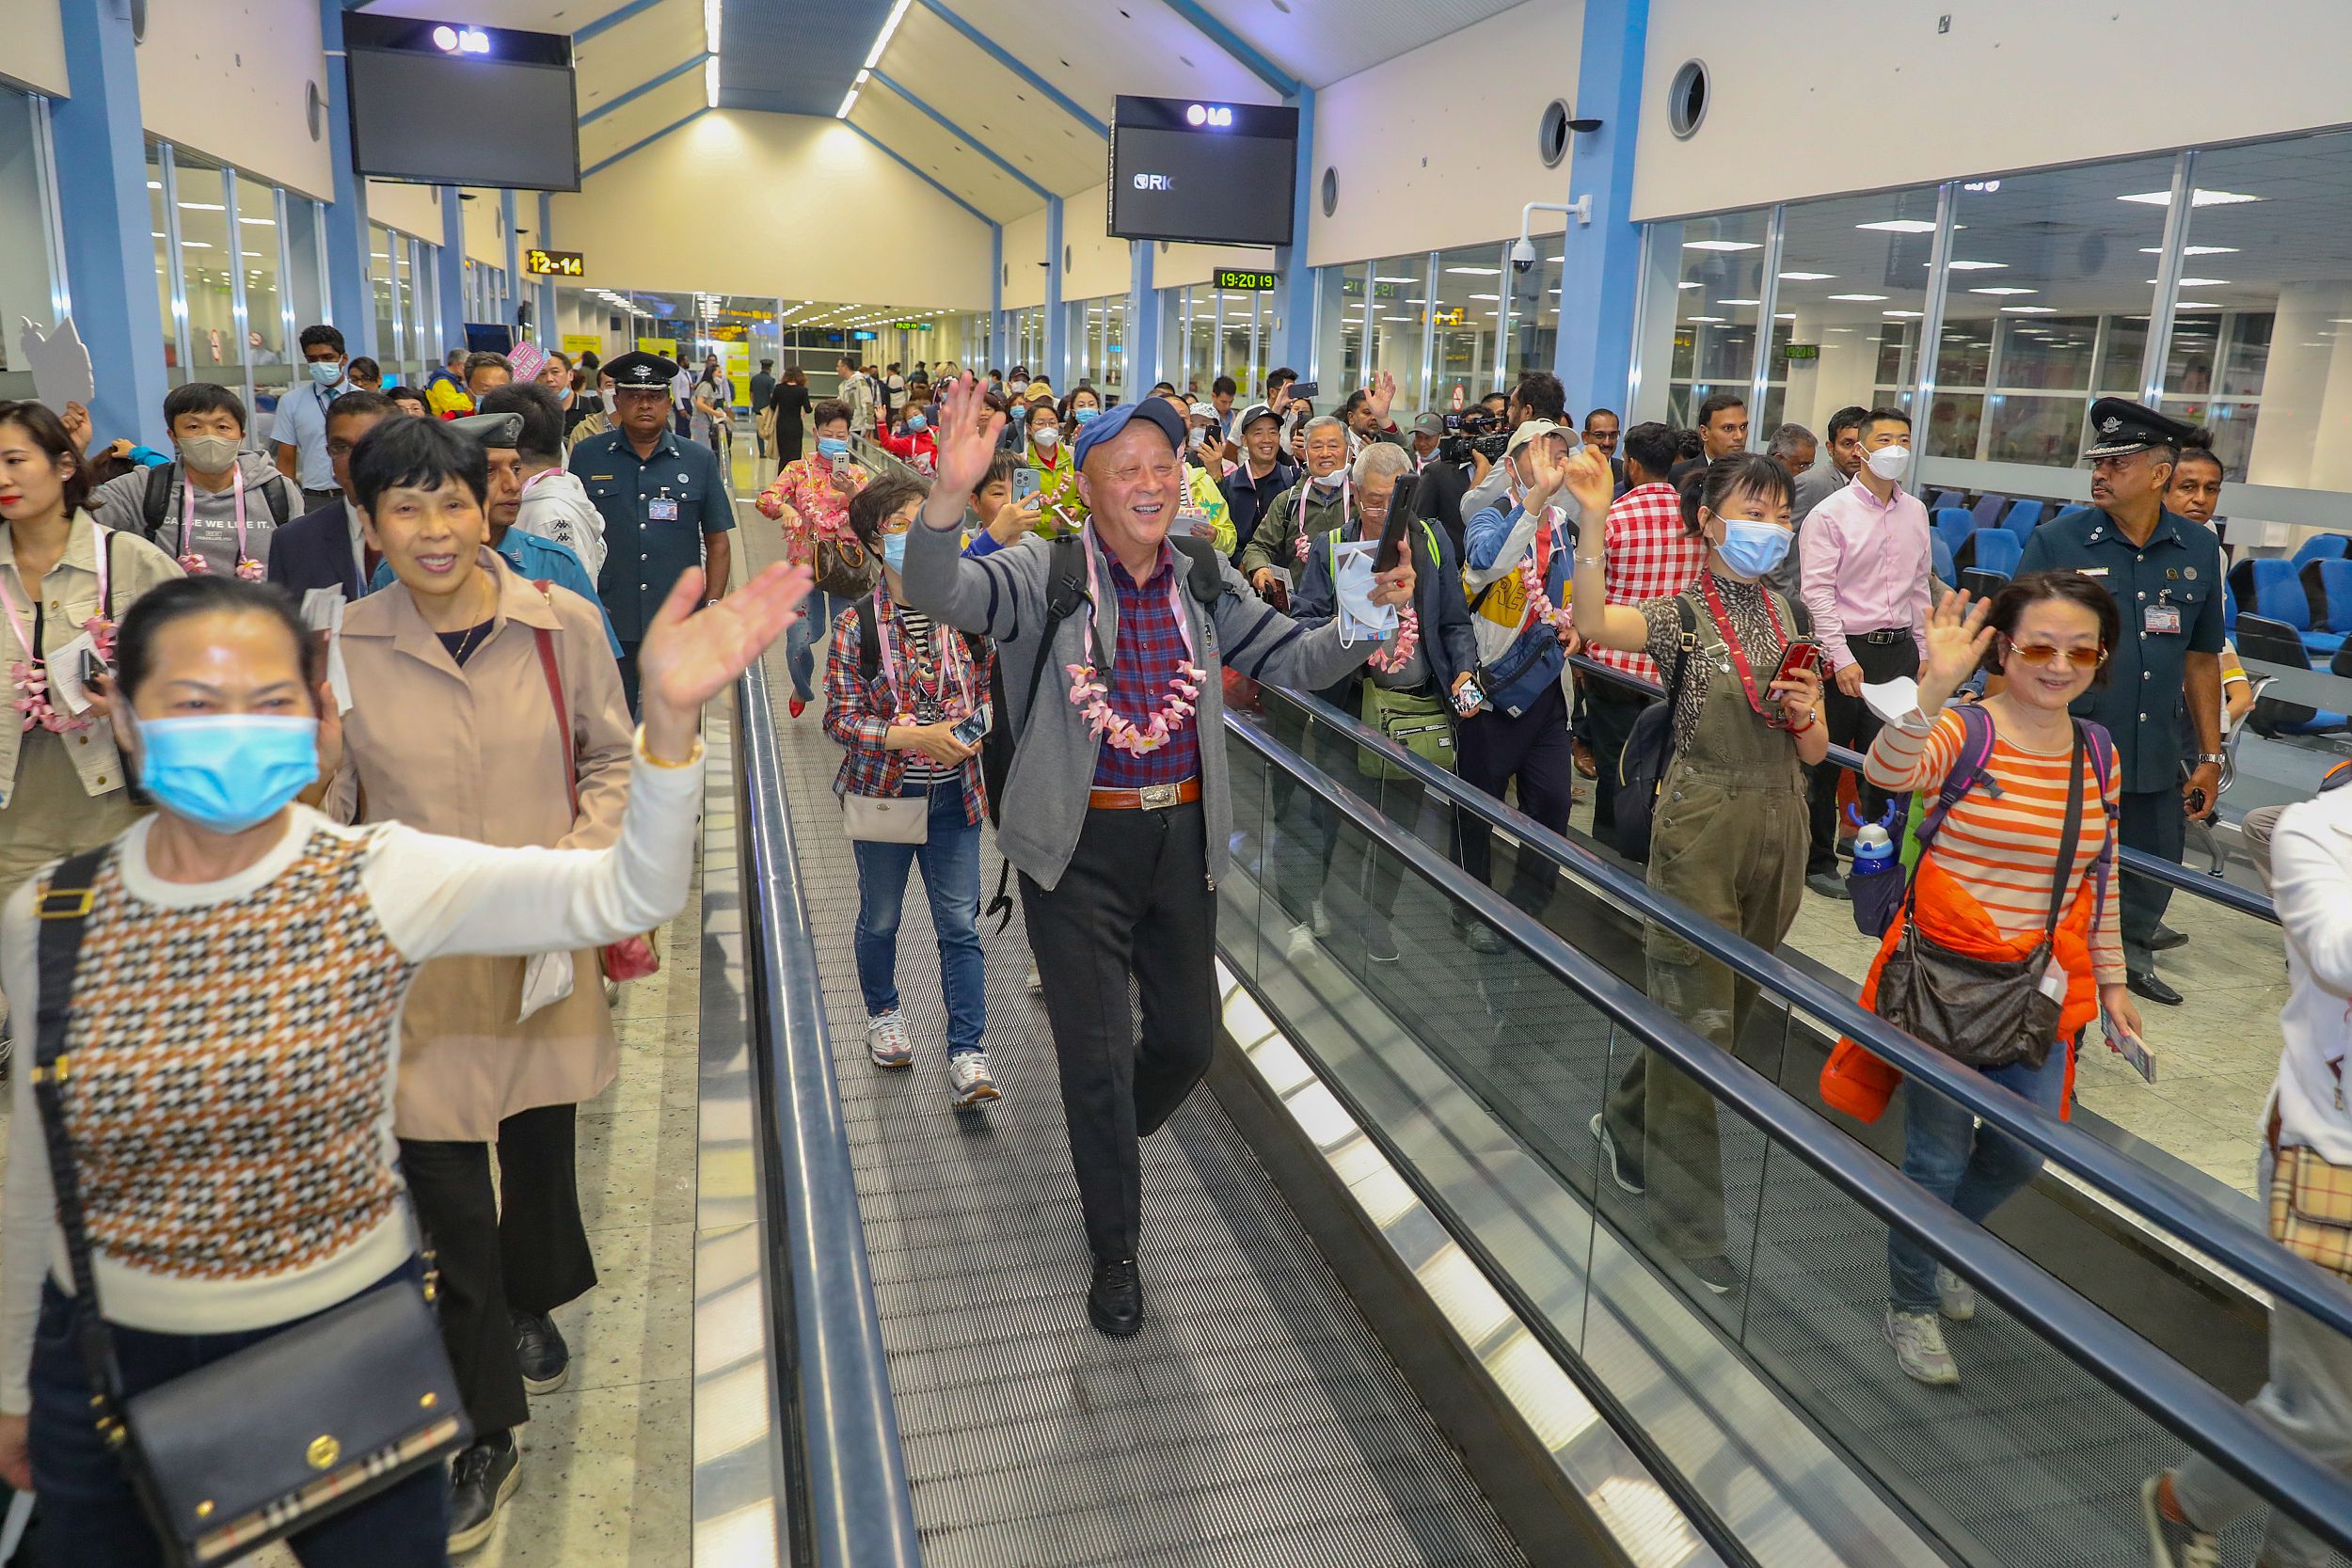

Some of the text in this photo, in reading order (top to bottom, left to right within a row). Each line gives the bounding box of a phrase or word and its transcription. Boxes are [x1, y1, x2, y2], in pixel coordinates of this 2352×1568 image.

[529, 256, 582, 276] 12-14
[1221, 273, 1273, 288] 19:20 19
[228, 520, 254, 529] LIE
[257, 520, 270, 529] IT.
